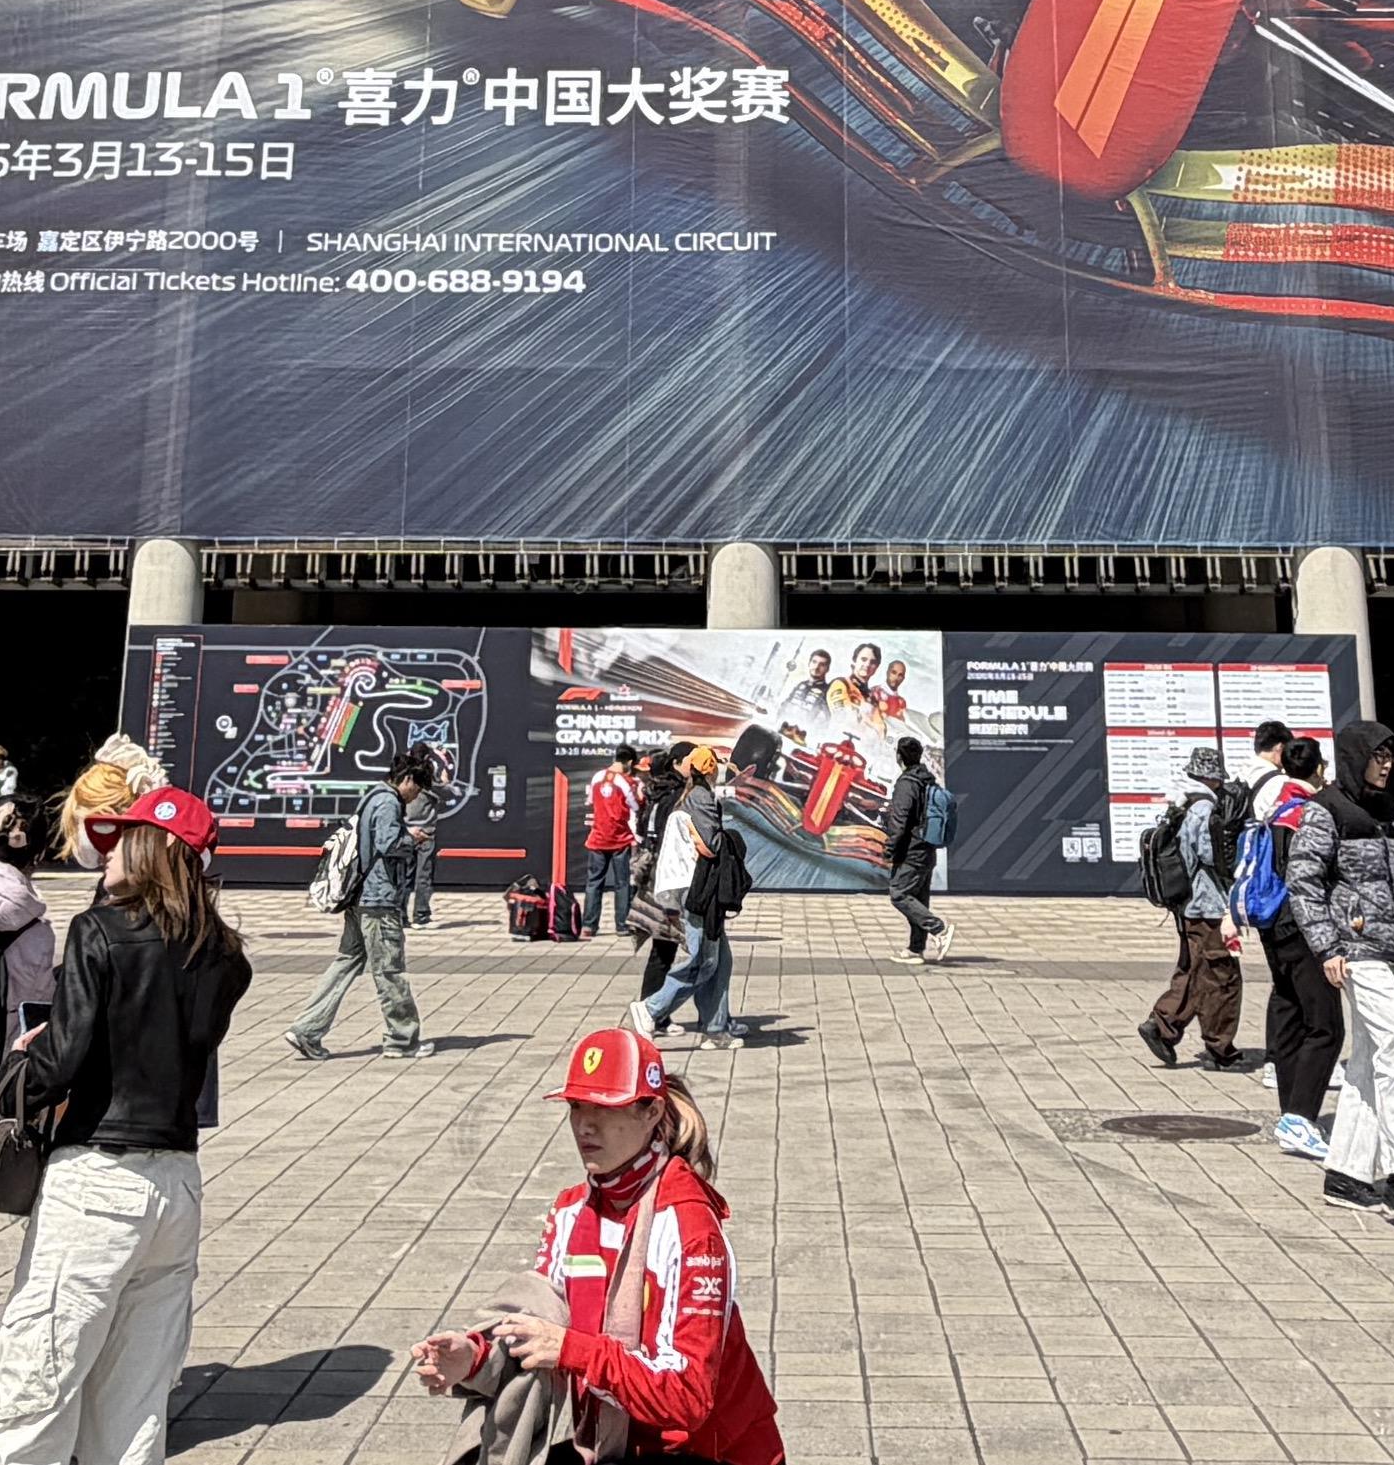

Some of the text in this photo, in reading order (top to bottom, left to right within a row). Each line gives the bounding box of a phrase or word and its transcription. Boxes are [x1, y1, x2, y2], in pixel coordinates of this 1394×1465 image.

[36, 230, 259, 253] 嘉定区伊宁路2000号
[306, 233, 447, 253] SHANGHAI
[453, 233, 669, 253] INTERNATIONAL
[674, 232, 777, 252] CIRCUIT
[49, 271, 137, 293] Official
[143, 271, 236, 293] Tickets
[241, 271, 341, 293] Hotline:
[345, 269, 586, 294] 400-688-9194
[967, 661, 1019, 671] FORMULA
[967, 690, 1018, 704] TIME
[968, 706, 1067, 720] SCHEDULE
[556, 714, 636, 729] CHINESE
[556, 730, 672, 745] GRAND PRIX
